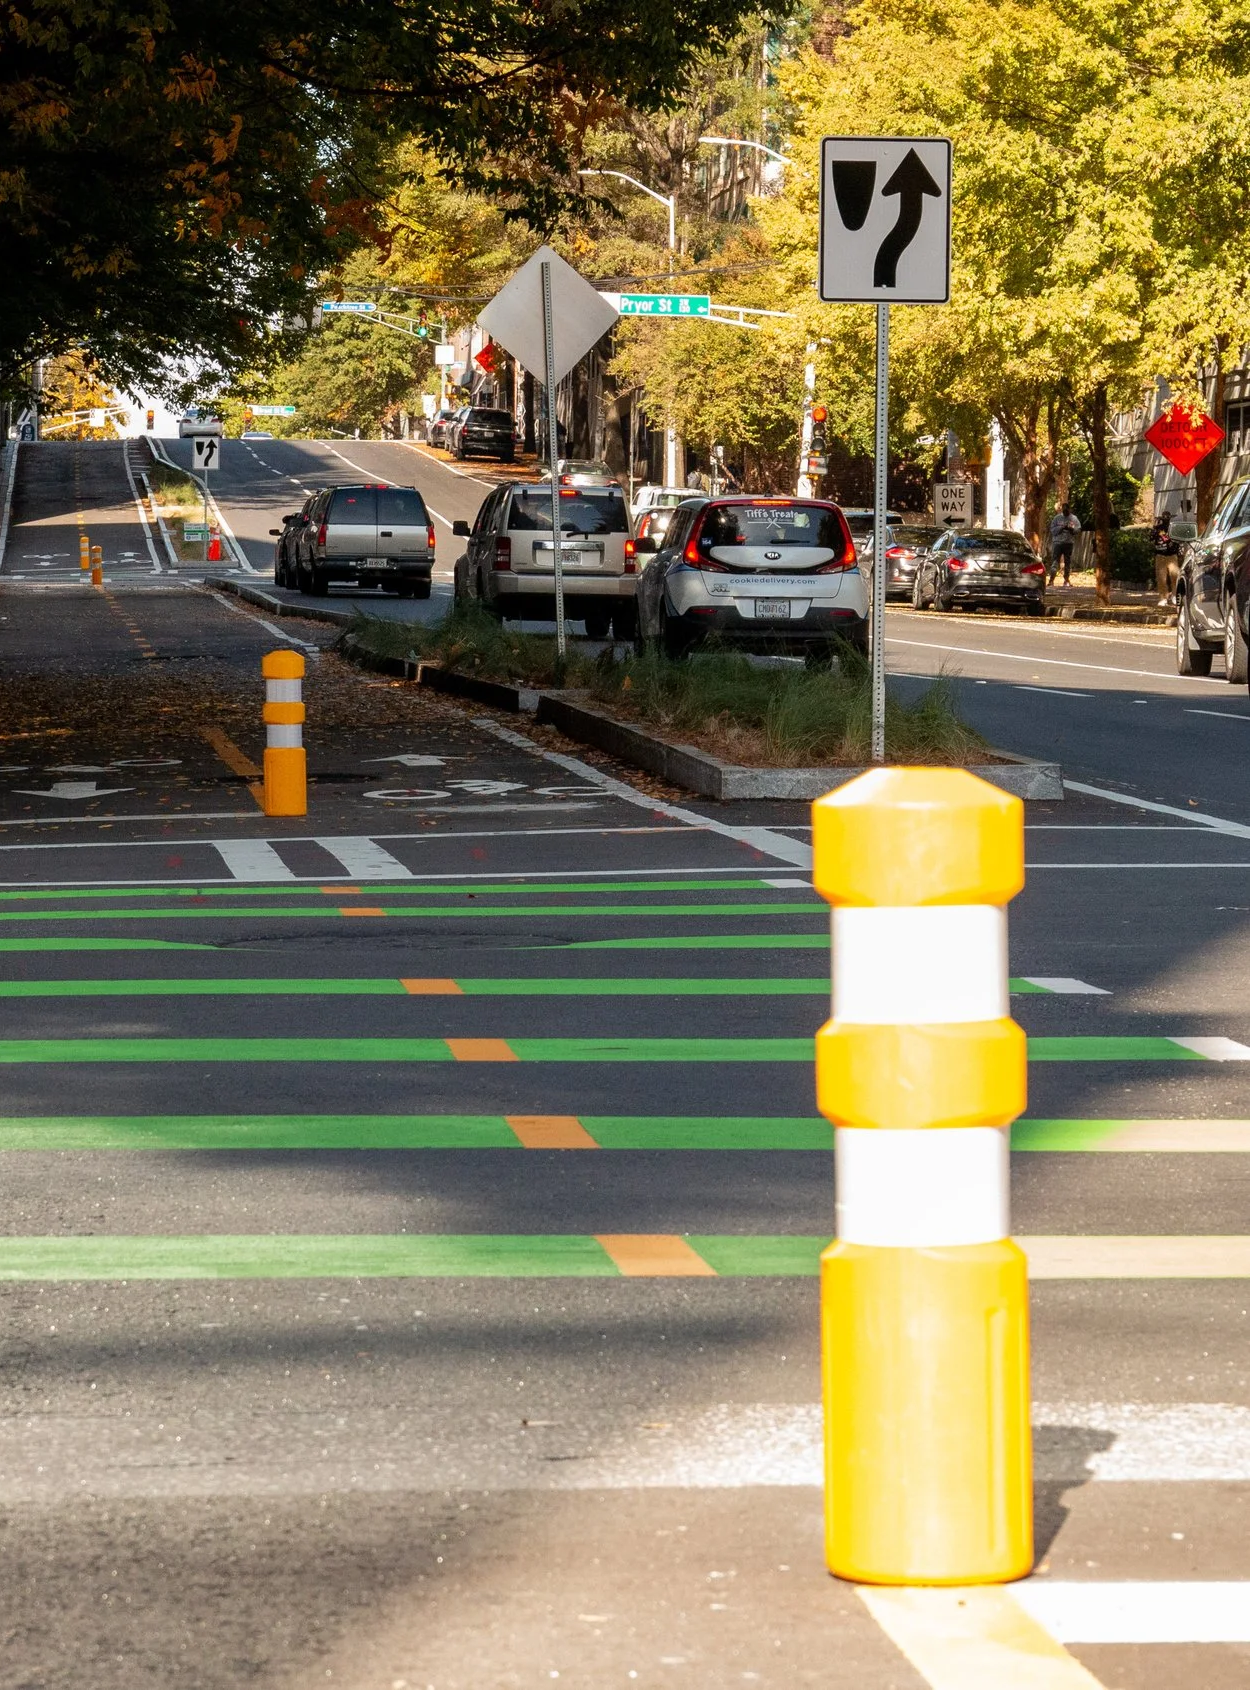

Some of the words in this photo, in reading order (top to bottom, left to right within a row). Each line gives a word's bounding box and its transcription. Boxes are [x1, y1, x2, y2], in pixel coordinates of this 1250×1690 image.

[621, 297, 654, 313] Pryor
[658, 298, 672, 313] St
[1161, 438, 1189, 449] 1000
[1194, 437, 1207, 449] FT
[941, 488, 965, 498] ONE
[941, 501, 965, 511] WAY
[745, 509, 768, 518] Tiff's
[729, 577, 815, 585] cookiedelivery.com
